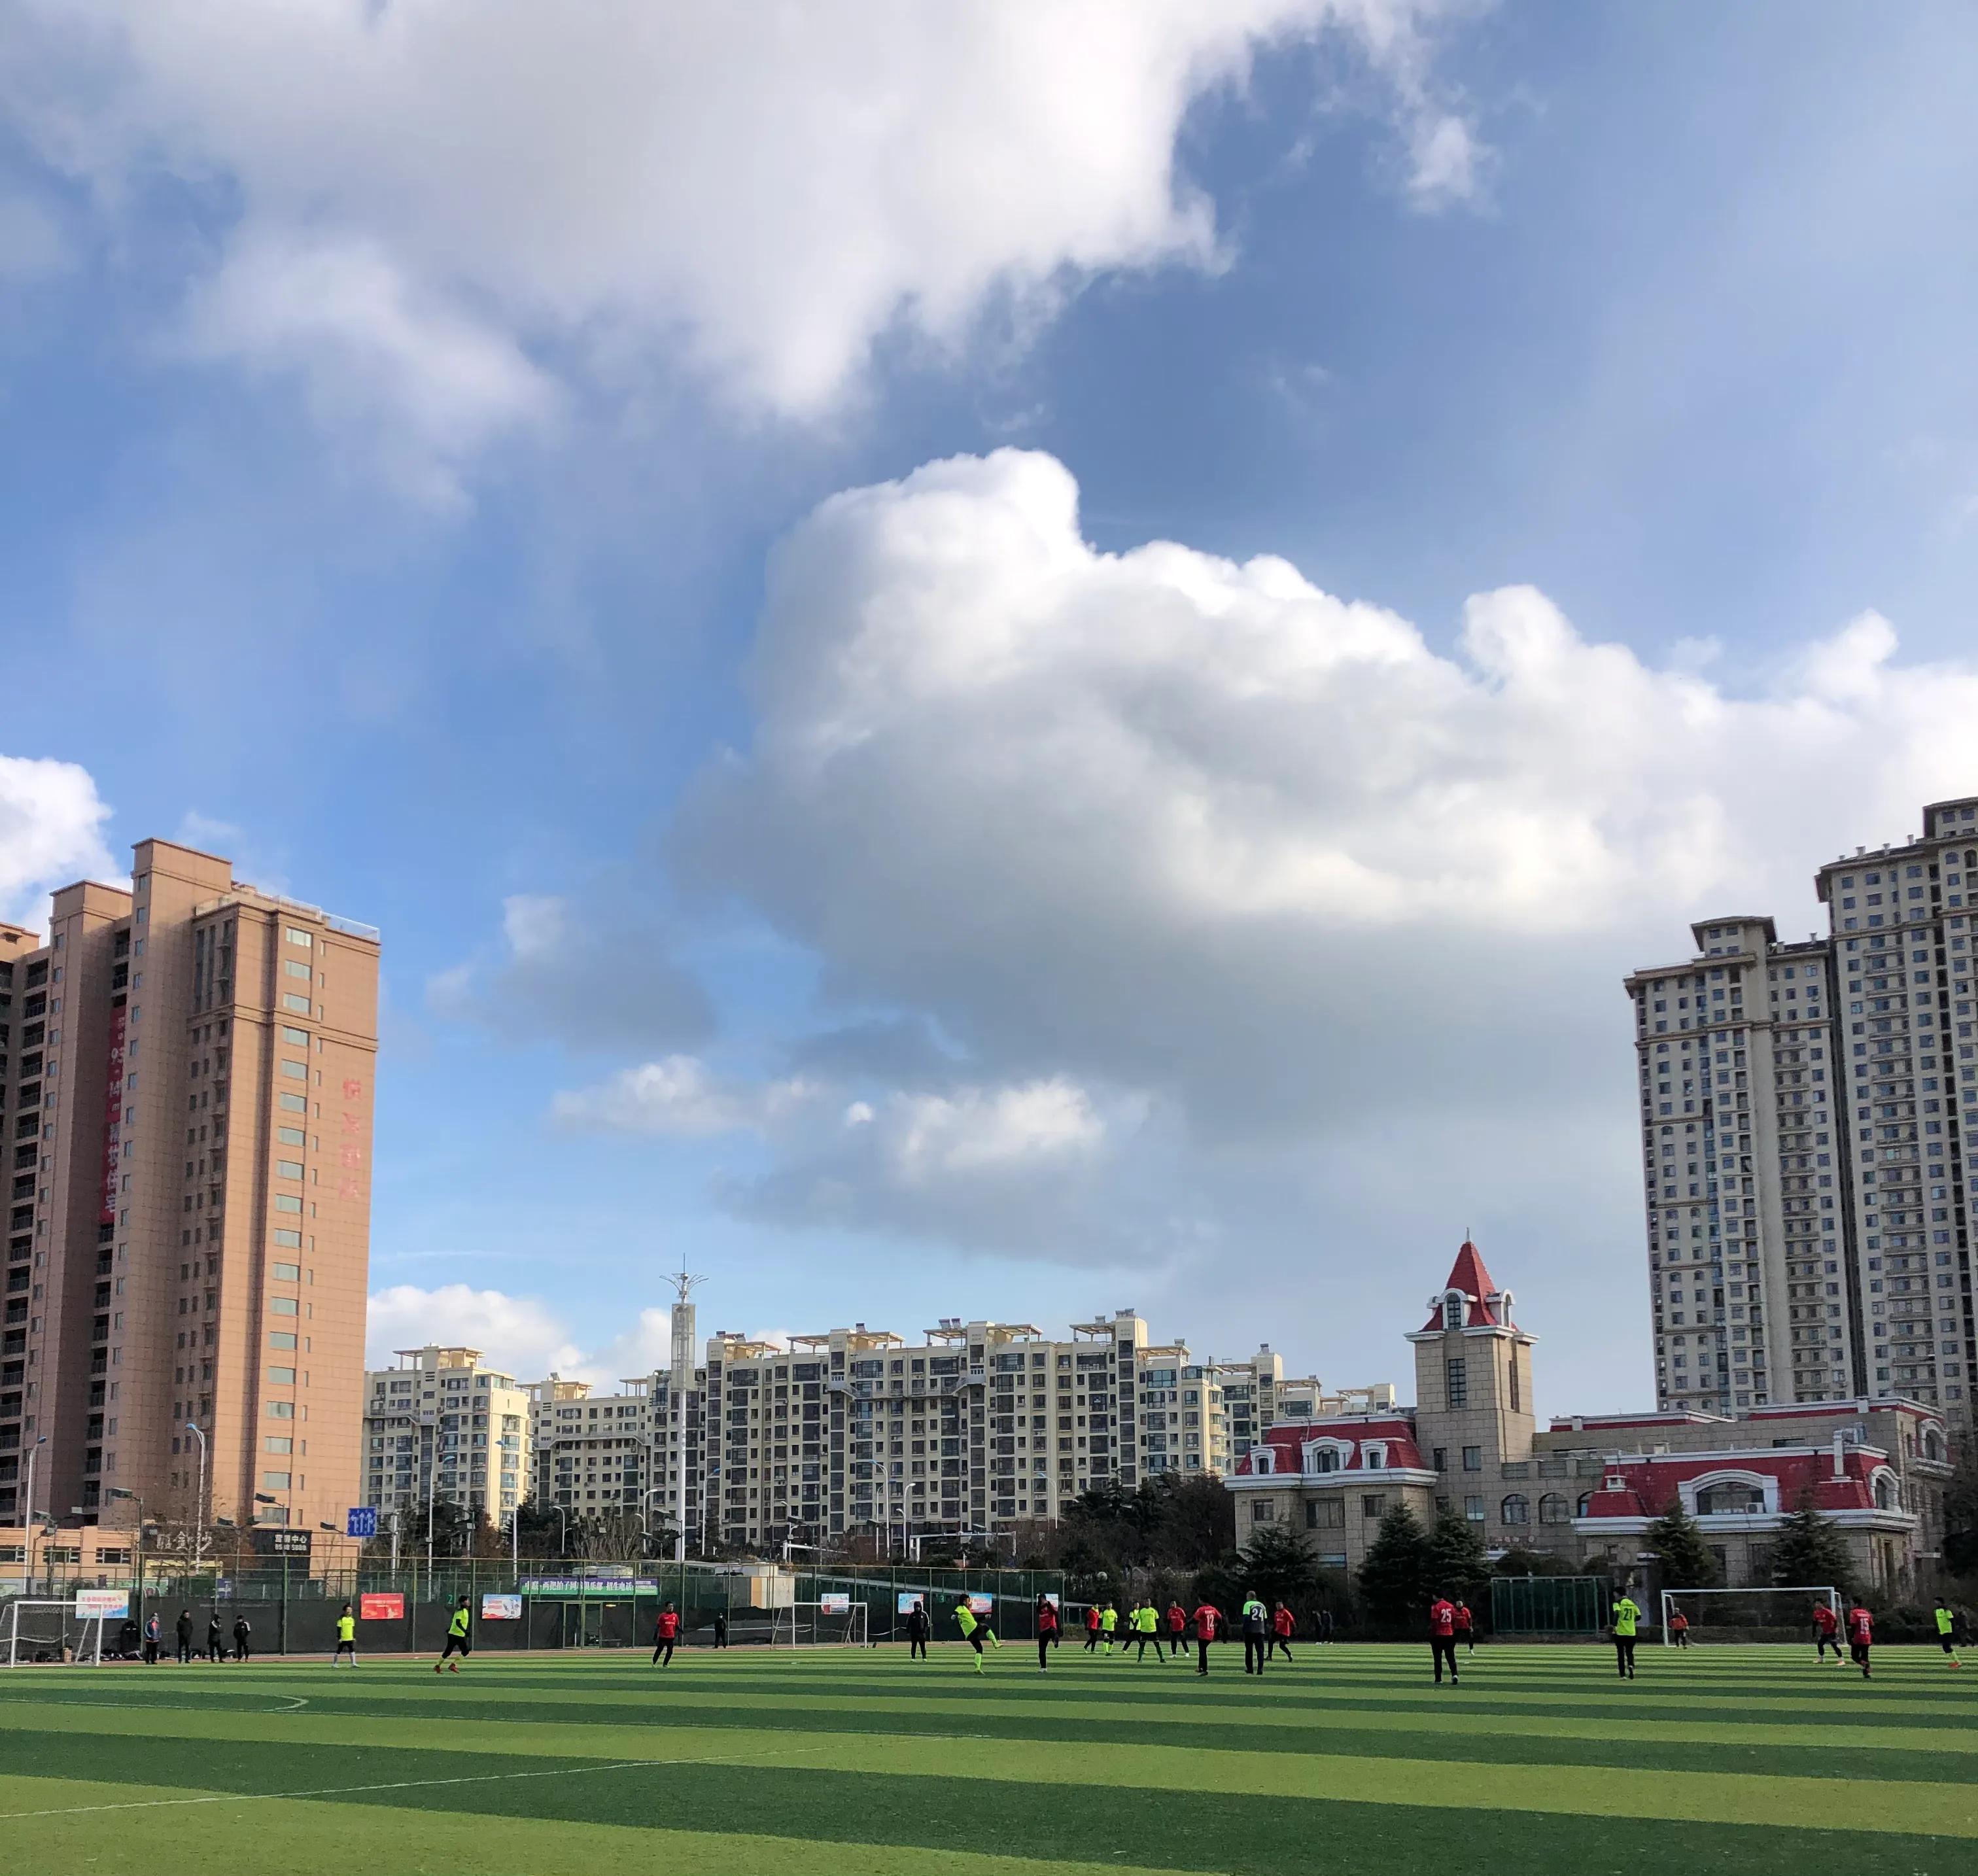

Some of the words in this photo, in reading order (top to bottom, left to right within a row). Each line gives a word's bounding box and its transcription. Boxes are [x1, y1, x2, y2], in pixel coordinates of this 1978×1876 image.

[1251, 1608, 1264, 1622] 24
[1440, 1608, 1452, 1623] 25
[1622, 1607, 1633, 1621] 21
[1207, 1614, 1215, 1631] 12
